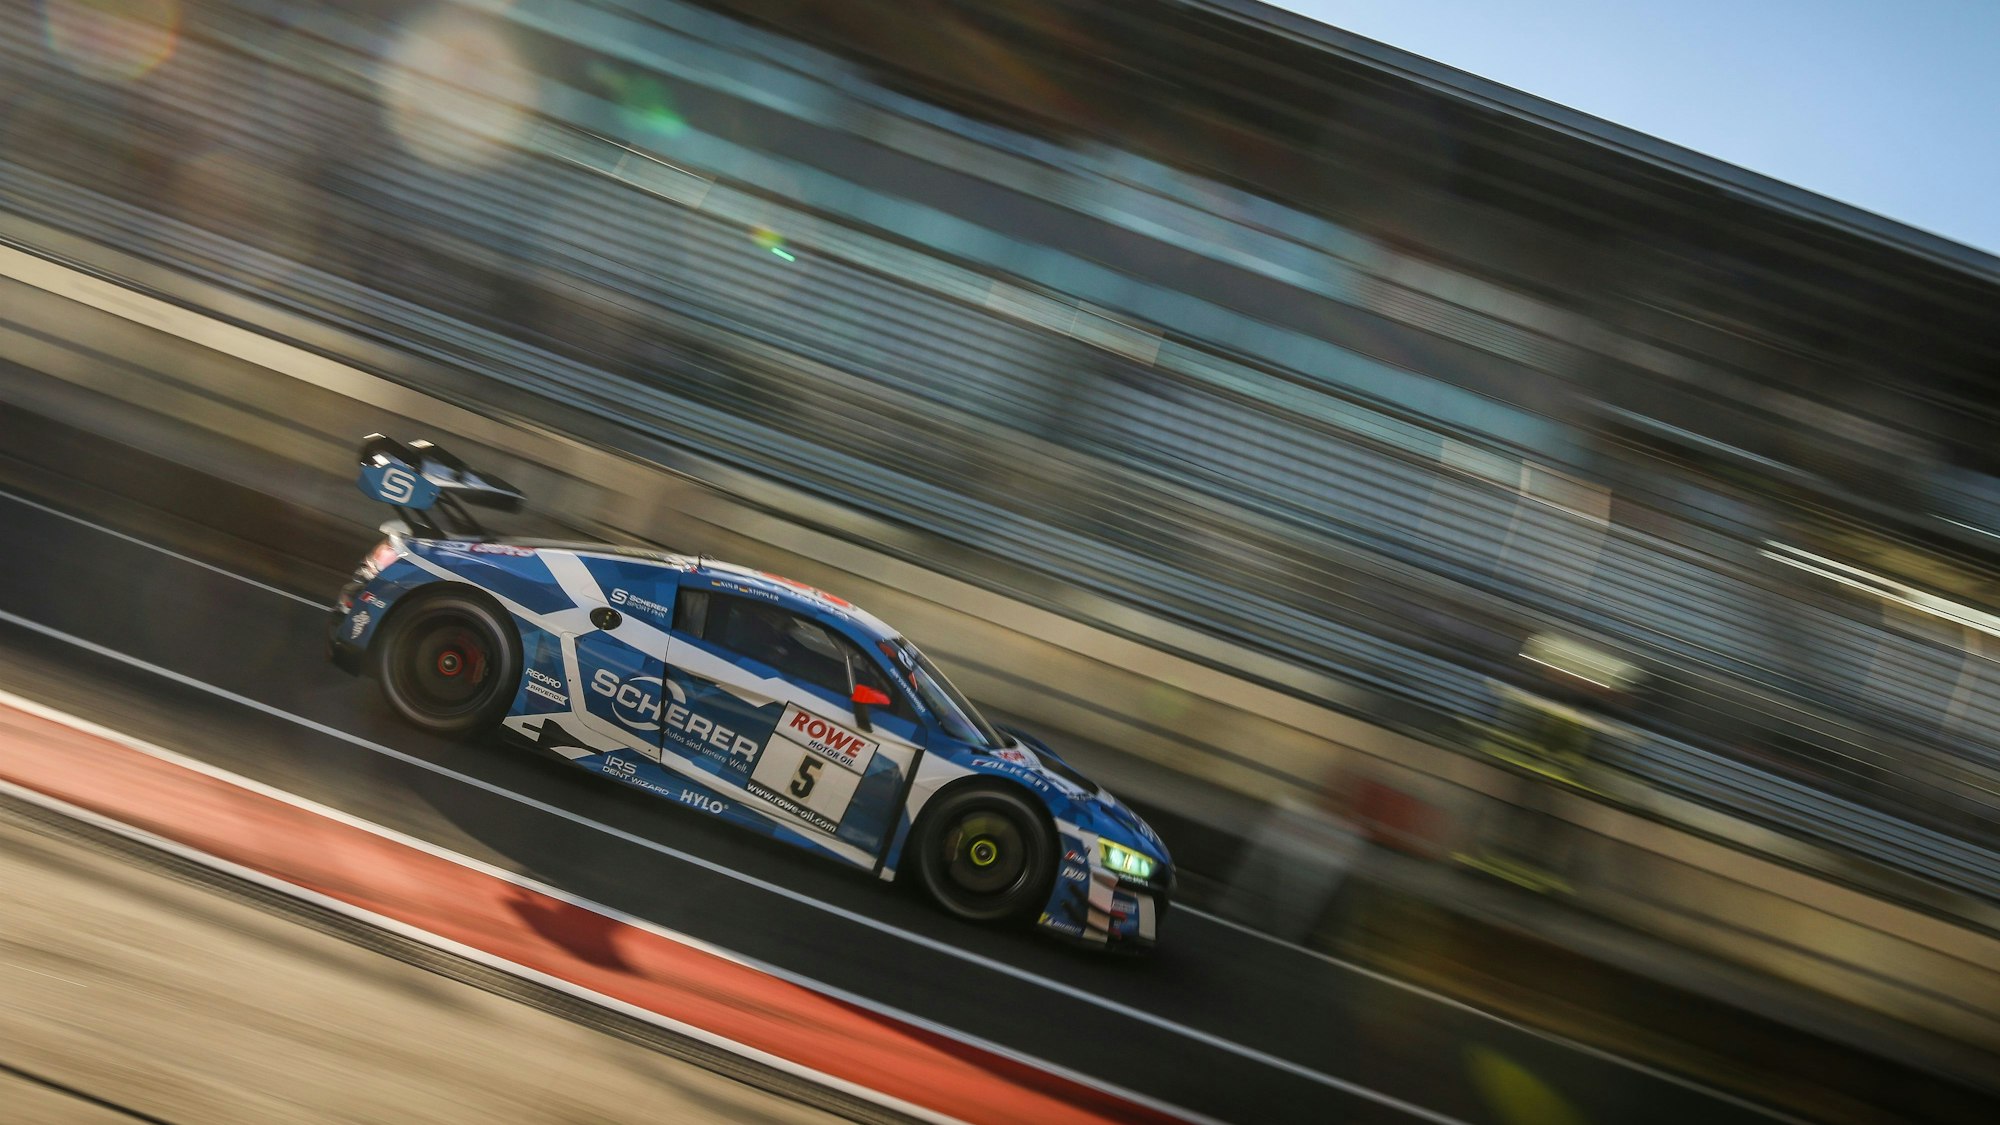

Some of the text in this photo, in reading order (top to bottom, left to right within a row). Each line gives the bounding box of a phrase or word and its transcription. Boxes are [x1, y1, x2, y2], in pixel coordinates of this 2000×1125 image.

[626, 600, 650, 613] SPORT
[629, 594, 668, 614] SCHERER
[525, 667, 562, 689] RECARO
[530, 683, 563, 702] RAVENOL
[590, 668, 759, 763] SCHERER
[663, 728, 686, 744] Autos
[686, 738, 703, 751] sind
[702, 747, 728, 763] unsere
[789, 710, 865, 759] ROWE
[605, 755, 638, 775] IRS
[808, 740, 854, 767] MOTOR OIL
[602, 765, 671, 796] DENT WIZARD
[789, 755, 824, 799] 5
[747, 782, 837, 833] www.rowe-oil.com
